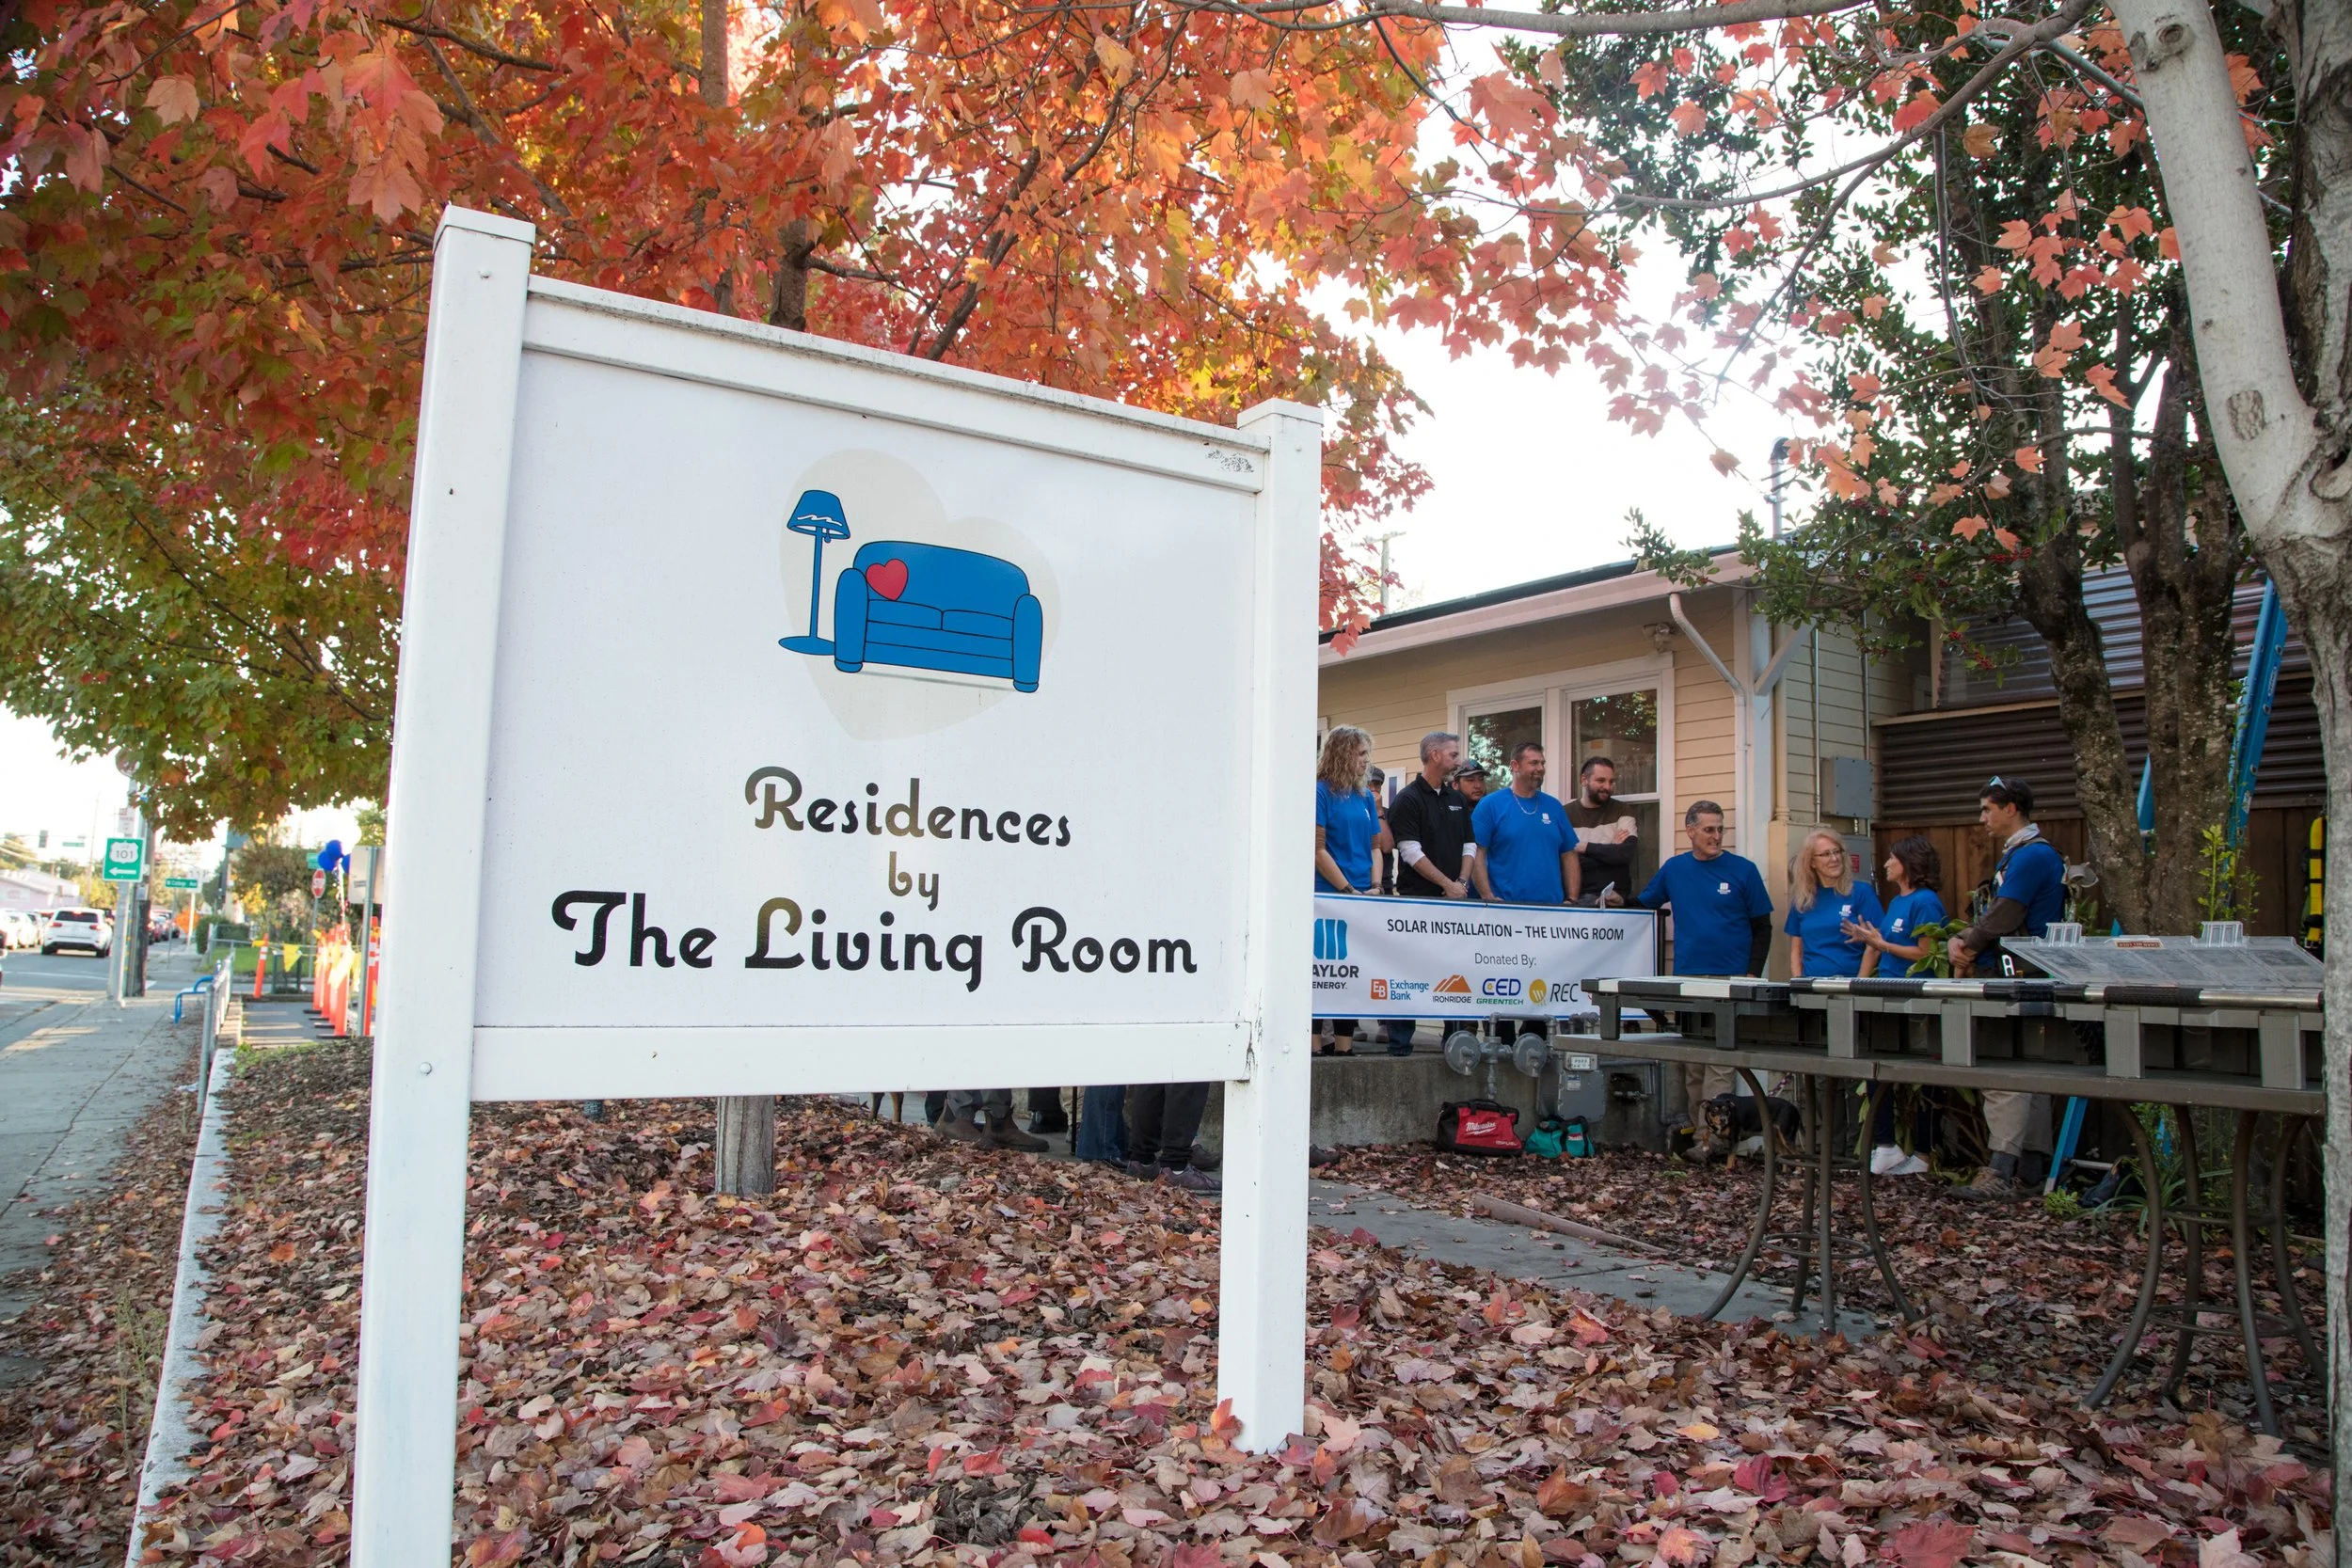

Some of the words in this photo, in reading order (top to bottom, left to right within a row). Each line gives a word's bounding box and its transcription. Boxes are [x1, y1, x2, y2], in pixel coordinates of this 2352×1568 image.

[744, 766, 1072, 847] Residences
[116, 849, 134, 859] 101
[888, 851, 940, 911] by
[1387, 918, 1428, 934] SOLAR
[1431, 921, 1512, 938] INSTALLATION
[1524, 926, 1548, 939] THE
[1550, 927, 1589, 940] LIVING
[1592, 927, 1625, 941] ROOM
[551, 890, 718, 969] The
[744, 896, 983, 993] Living
[1011, 906, 1198, 974] Room
[1474, 952, 1518, 965] Donated
[1521, 954, 1536, 969] By:
[1390, 978, 1430, 992] Exchange
[1482, 978, 1522, 996] CED
[1549, 983, 1580, 1003] REC
[1391, 990, 1411, 1001] Bank
[1432, 995, 1472, 1004] IRONRIDGE
[1476, 997, 1524, 1006] GREENTECH
